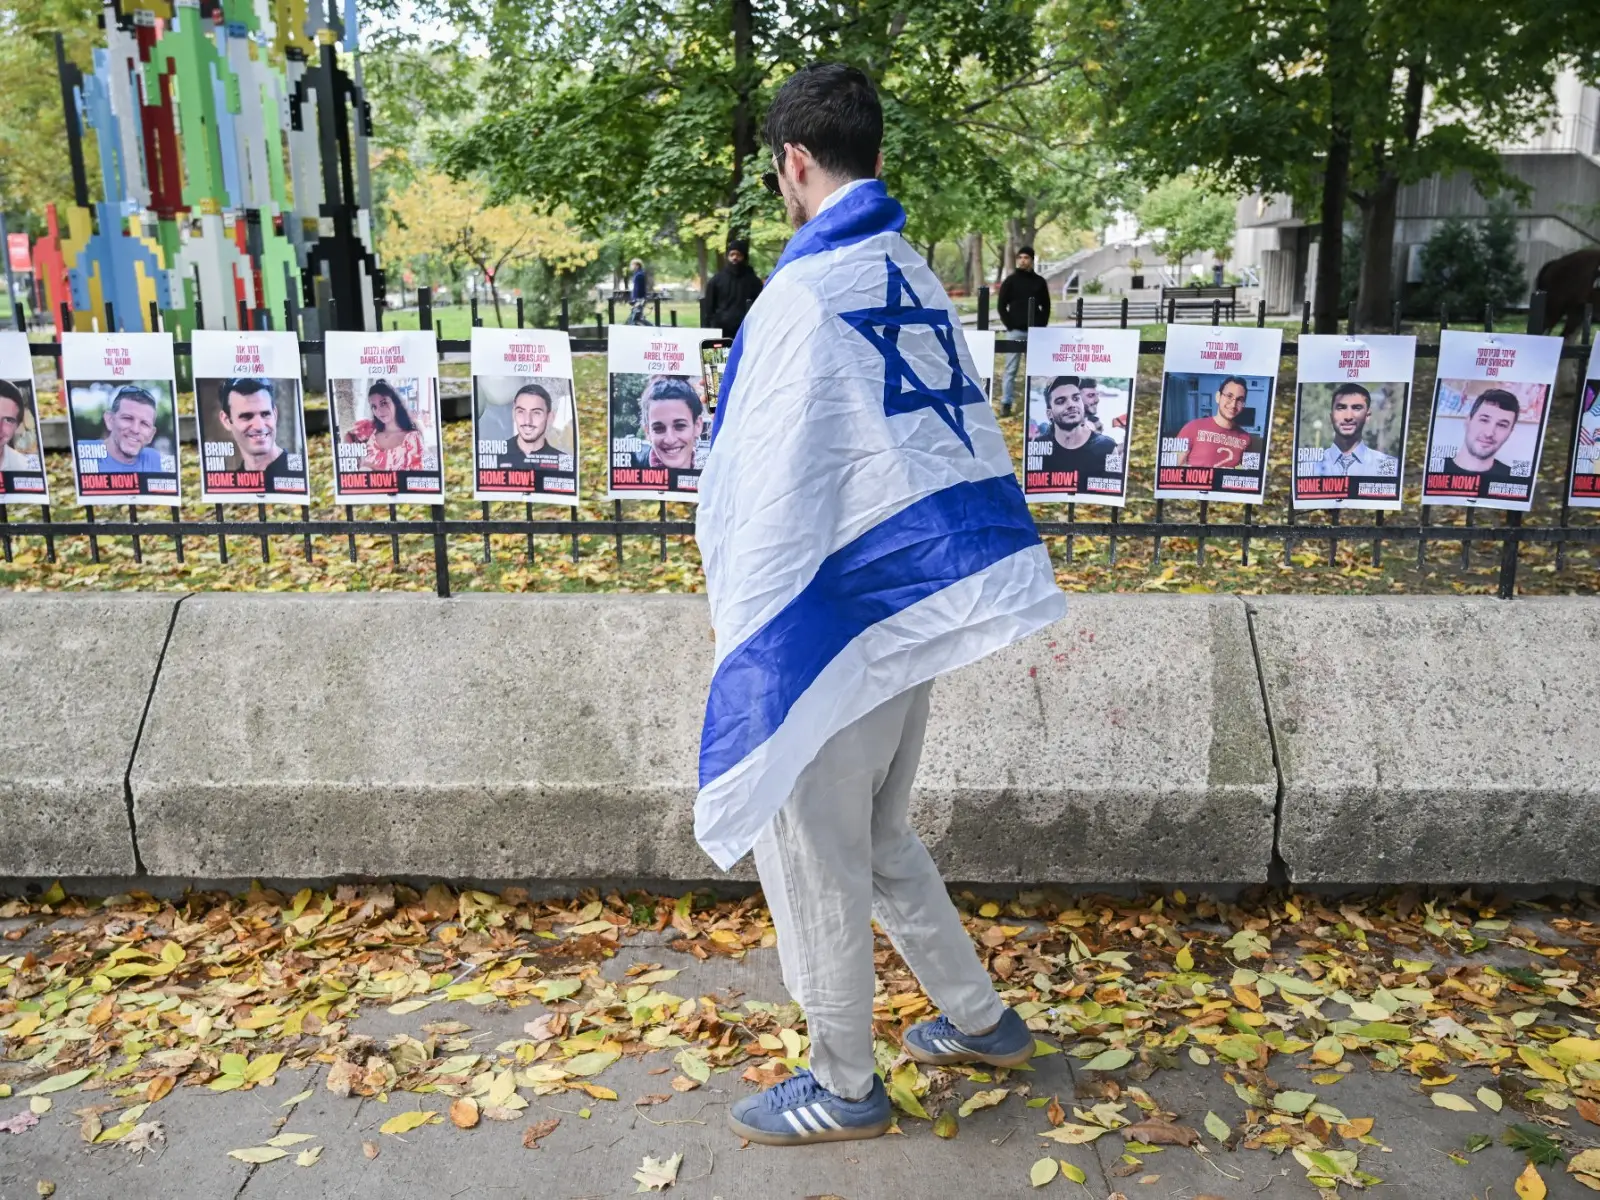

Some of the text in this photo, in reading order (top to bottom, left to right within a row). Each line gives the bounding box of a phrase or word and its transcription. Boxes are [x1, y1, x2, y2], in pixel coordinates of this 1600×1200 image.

[104, 358, 113, 366] TAL
[644, 352, 684, 361] ARBEL YEHOUD
[1052, 353, 1111, 363] YOSEF-CHAIM OHANA
[1200, 351, 1217, 359] TAMIR
[368, 366, 386, 374] (20)
[514, 364, 531, 372] (20)
[648, 362, 665, 371] (29)
[1074, 362, 1087, 372] (24)
[1476, 358, 1514, 368] ITAY SVIRSKY
[112, 366, 124, 376] (42)
[1347, 369, 1359, 378] (23)
[77, 444, 107, 459] BRING
[204, 442, 234, 456] BRING
[338, 443, 368, 457] BRING
[479, 440, 507, 454] BRING
[613, 438, 642, 452] BRING
[1028, 441, 1053, 456] BRING
[1162, 437, 1189, 452] BRING
[1161, 452, 1177, 466] HIM
[1298, 448, 1324, 462] BRING
[1432, 445, 1458, 459] BRING
[80, 459, 99, 473] HIM
[206, 457, 225, 471] HIM
[339, 458, 359, 472] HER
[479, 455, 498, 469] HIM
[613, 453, 632, 467] HER
[1027, 456, 1043, 471] HIM
[1429, 458, 1445, 472] HIM
[613, 469, 640, 483] HOME
[642, 468, 668, 484] NOW!
[1160, 468, 1213, 484] HOME NOW!
[1297, 462, 1314, 476] HIM
[81, 475, 109, 488] HOME
[110, 473, 139, 488] NOW!
[207, 473, 235, 487] HOME
[236, 471, 265, 487] NOW!
[340, 474, 368, 488] HOME
[370, 472, 397, 487] NOW!
[479, 471, 506, 485] HOME
[508, 470, 534, 486] NOW!
[1027, 470, 1078, 487] HOME NOW!
[1297, 477, 1348, 492] HOME NOW!
[1427, 475, 1450, 489] HOME
[1451, 475, 1480, 490] NOW!
